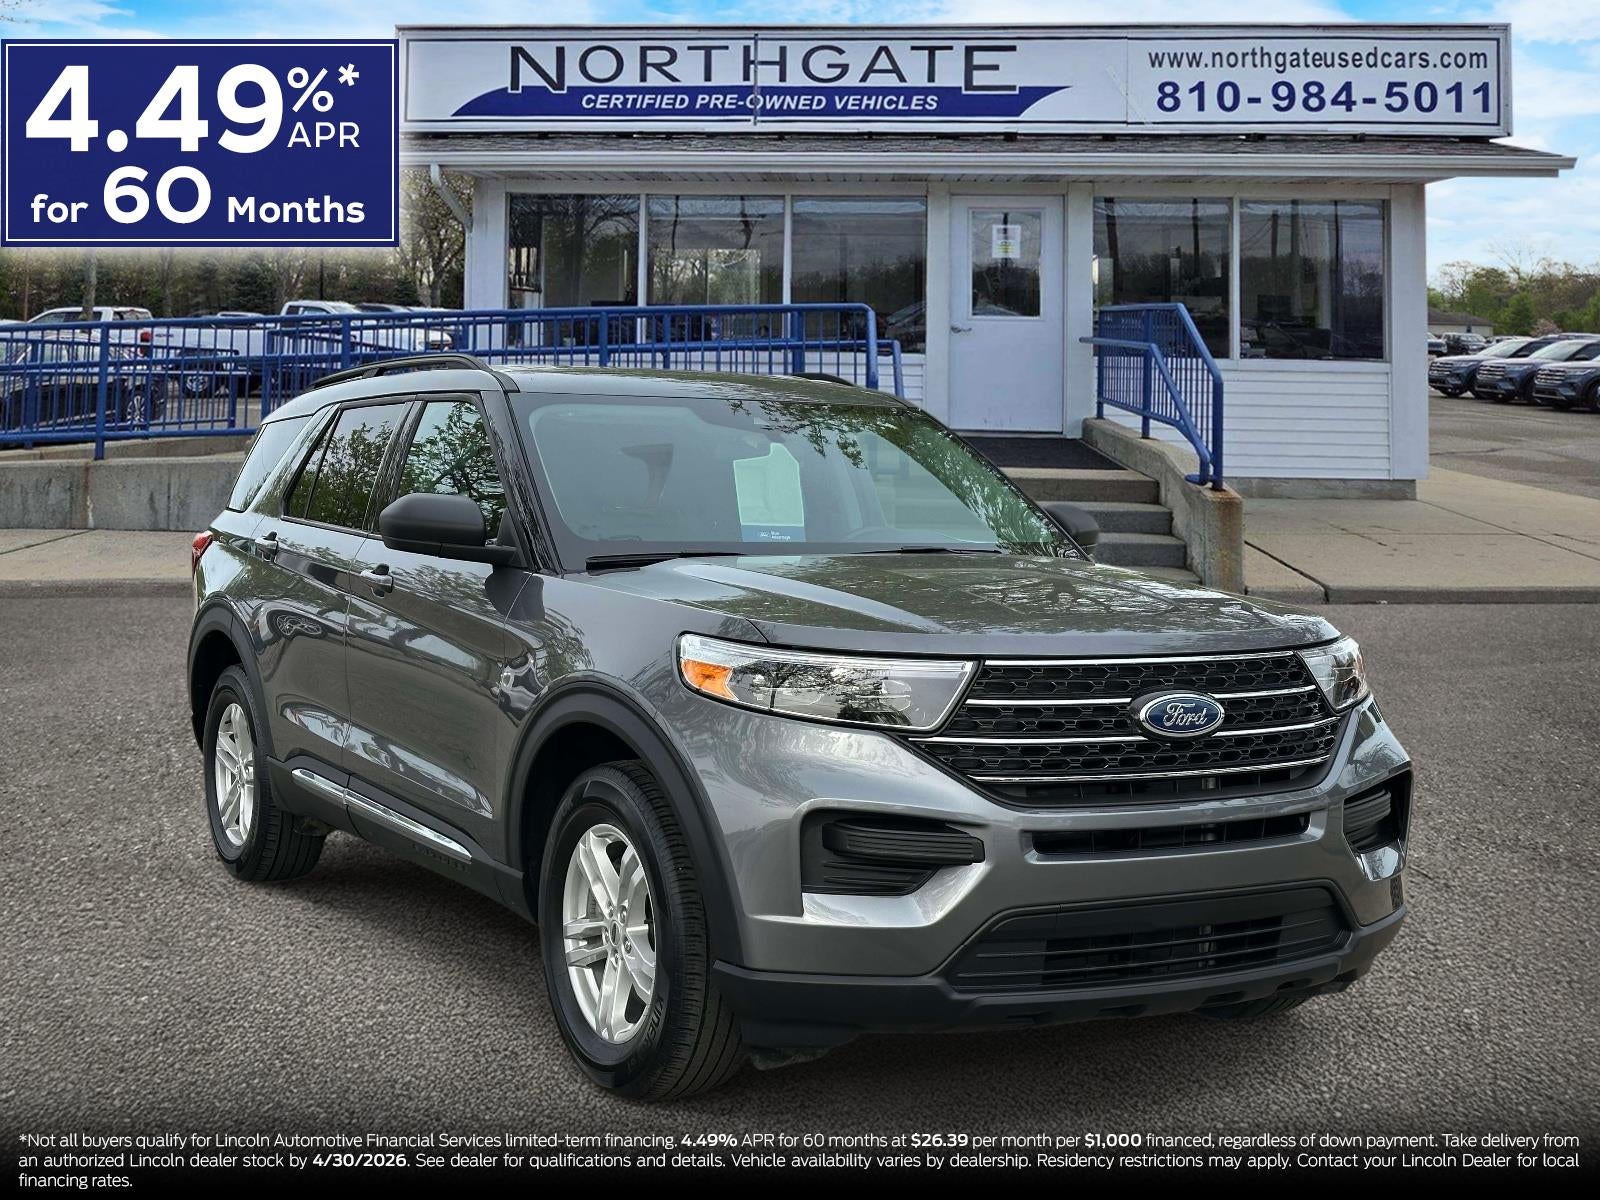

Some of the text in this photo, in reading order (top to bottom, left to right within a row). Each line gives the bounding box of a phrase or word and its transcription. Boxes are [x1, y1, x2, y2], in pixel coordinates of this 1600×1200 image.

[509, 44, 1017, 92] NORTHGATE
[1149, 46, 1488, 73] www.northgateusedcars.com
[581, 93, 939, 112] CERTIFIED PRE-OWNED VEHICLES
[1156, 80, 1492, 114] 810-984-5011
[1163, 702, 1208, 727] Ford
